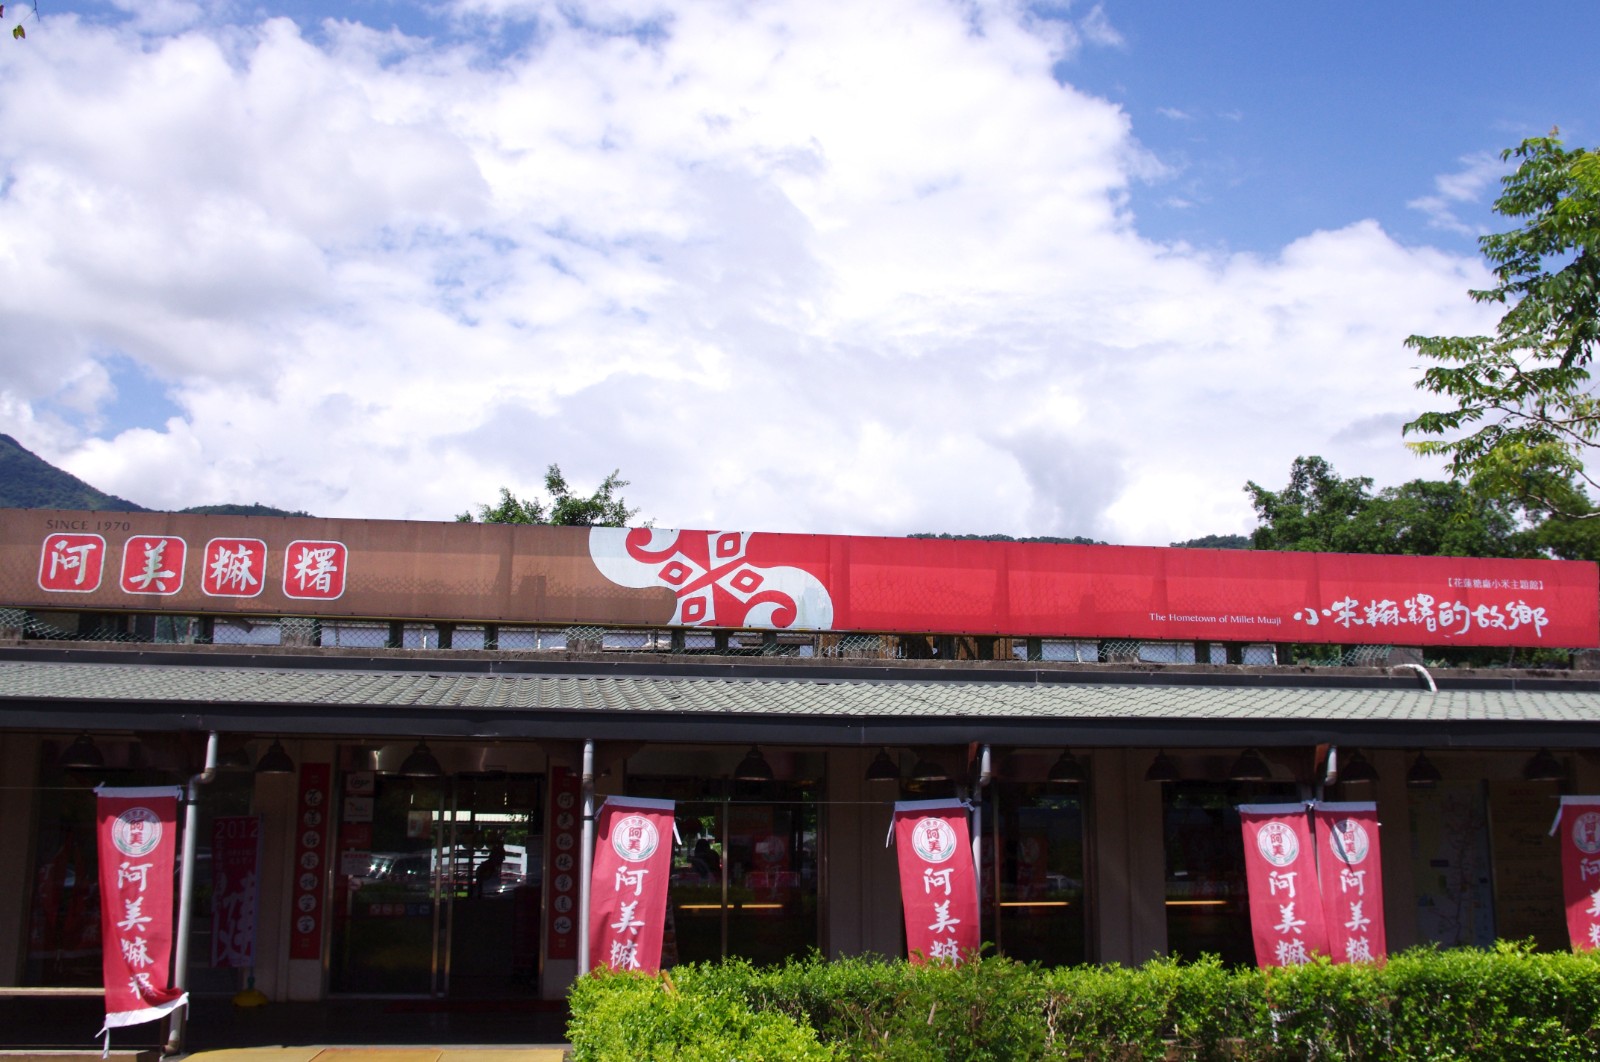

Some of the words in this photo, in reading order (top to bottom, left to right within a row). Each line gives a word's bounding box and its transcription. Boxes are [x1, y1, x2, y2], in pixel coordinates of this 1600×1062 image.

[46, 519, 89, 531] SINCE
[96, 521, 131, 532] 1970
[1149, 613, 1166, 621] The
[1168, 614, 1217, 623] Hometown
[1218, 615, 1228, 623] of
[1230, 615, 1255, 624] Millet
